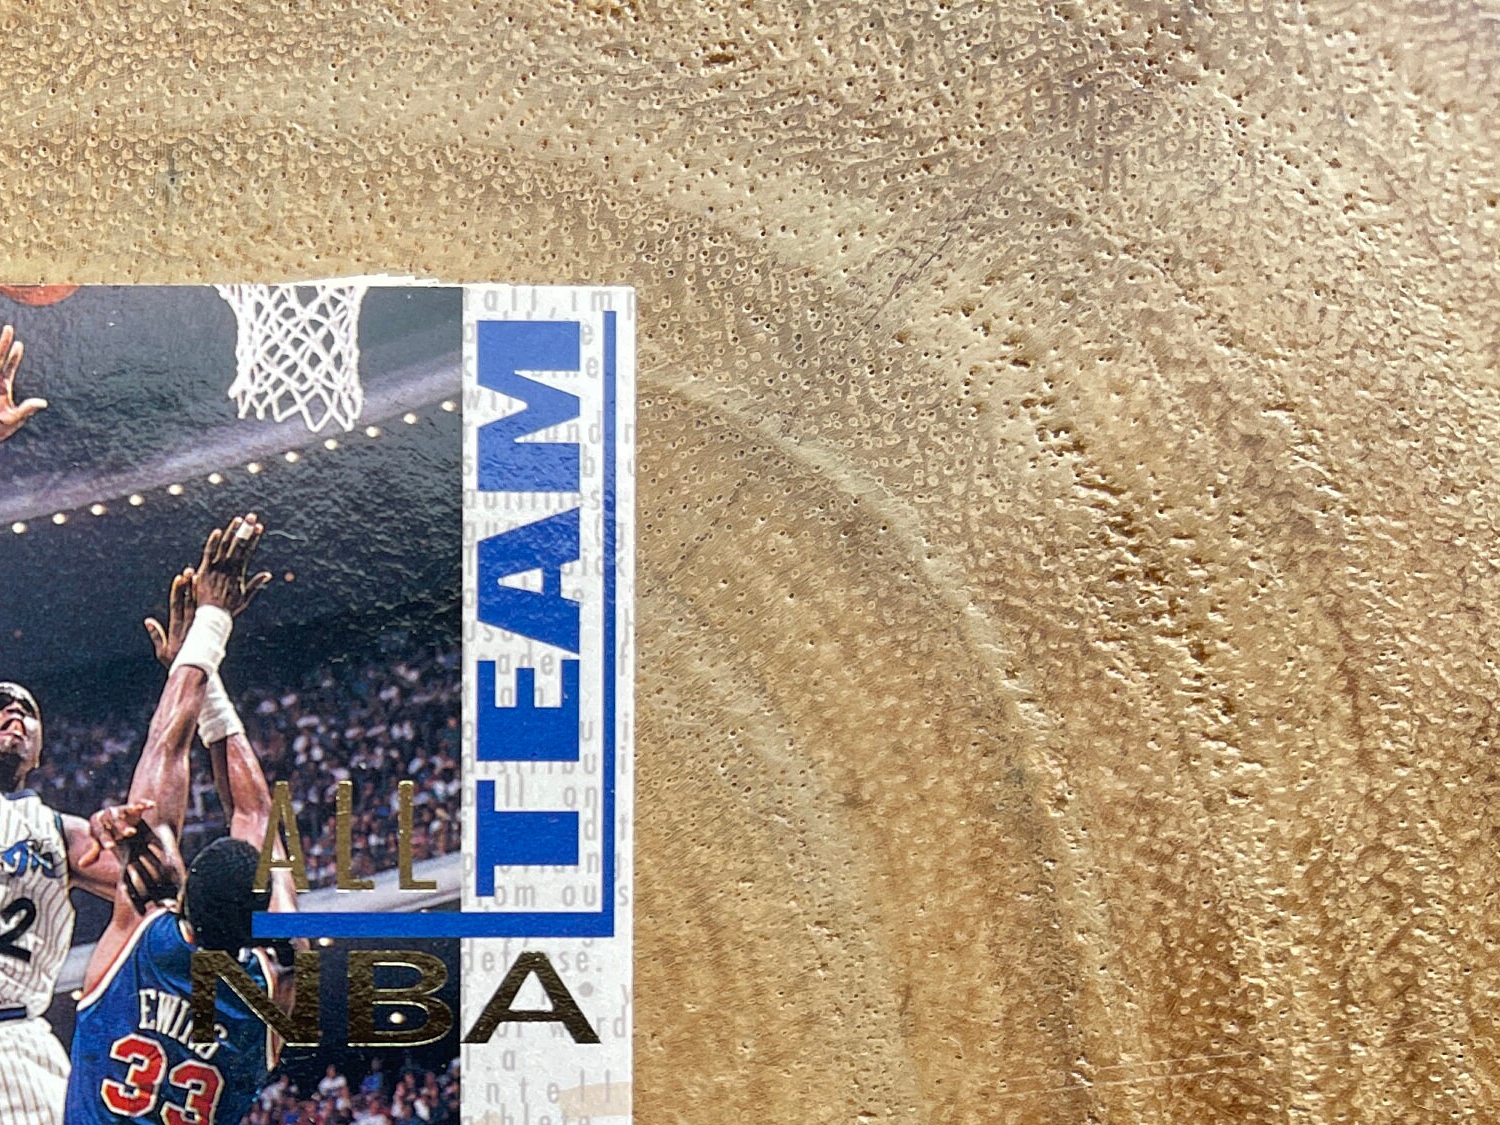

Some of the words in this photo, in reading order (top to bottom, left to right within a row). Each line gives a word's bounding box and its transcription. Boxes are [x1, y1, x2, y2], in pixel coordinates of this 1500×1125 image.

[476, 320, 581, 897] TEAM
[252, 780, 437, 893] ALL
[138, 988, 229, 1060] EWI
[190, 950, 602, 1047] NBA
